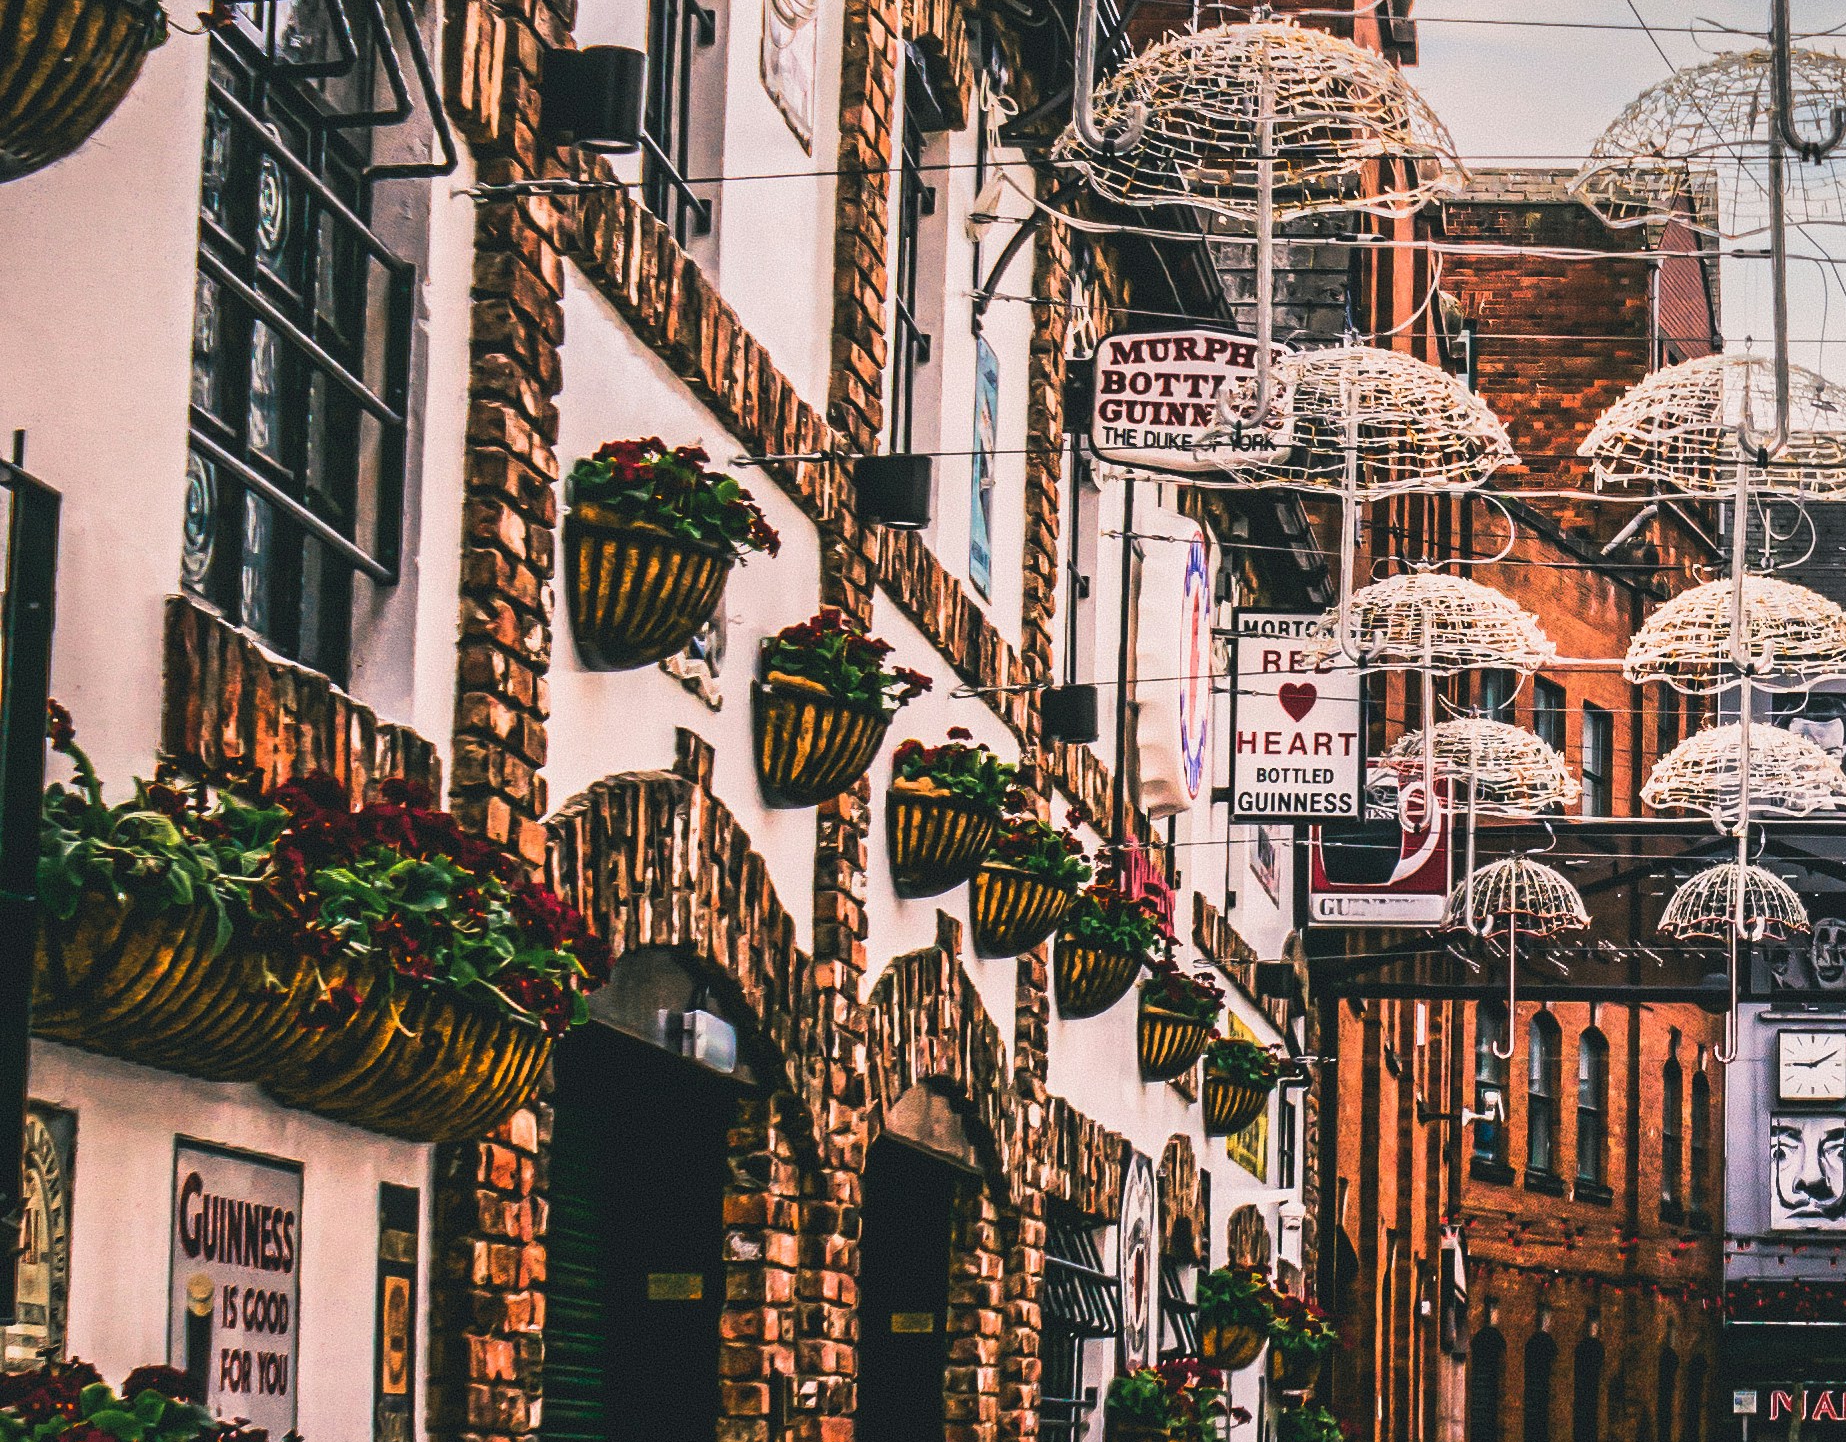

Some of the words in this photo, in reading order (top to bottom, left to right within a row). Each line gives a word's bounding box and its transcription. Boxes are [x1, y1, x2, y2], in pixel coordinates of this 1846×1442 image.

[1103, 426, 1137, 448] THE
[1144, 430, 1193, 452] DUKE
[1230, 433, 1277, 452] YORK
[1236, 731, 1357, 756] HEART
[1256, 767, 1334, 784] BOTTLED
[1238, 791, 1353, 813] GUINNESS
[179, 1170, 295, 1275] GUINNESS
[221, 1285, 239, 1330] IS
[243, 1286, 289, 1336] GOOD
[219, 1348, 252, 1393] FOR
[257, 1350, 289, 1397] YOU
